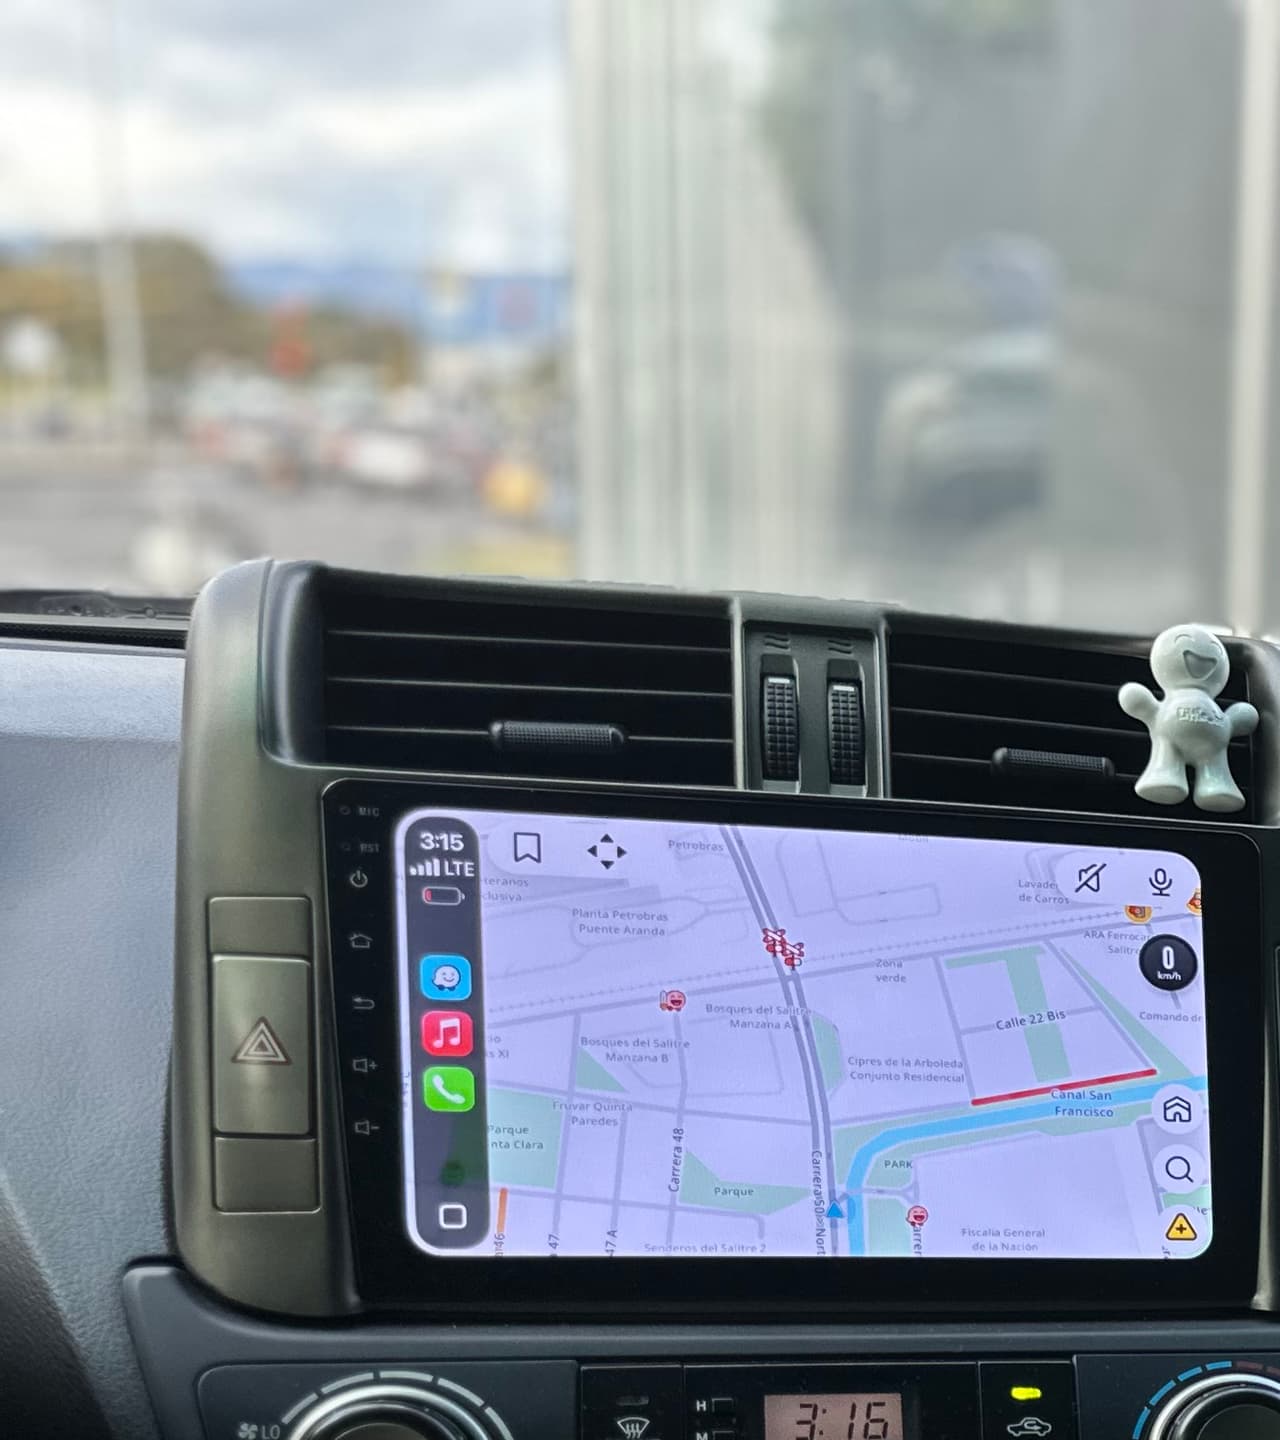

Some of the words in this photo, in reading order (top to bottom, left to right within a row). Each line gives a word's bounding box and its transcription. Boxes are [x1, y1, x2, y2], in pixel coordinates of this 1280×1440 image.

[420, 832, 464, 851] 3:15
[668, 839, 724, 852] Petrobras
[445, 861, 475, 877] LTE
[1019, 893, 1033, 903] de
[1035, 894, 1070, 905] Carros
[572, 908, 609, 920] Planta
[613, 910, 669, 922] Petrobras
[579, 923, 620, 936] Puente
[623, 925, 665, 937] Aranda
[1083, 931, 1105, 940] ARA
[875, 958, 903, 969] Zona
[1162, 945, 1175, 970] 0
[876, 973, 906, 984] verde
[1157, 971, 1182, 982] km/h
[706, 1003, 753, 1017] Bosques
[756, 1003, 773, 1015] del
[776, 1004, 812, 1017] Salitre
[1139, 1011, 1189, 1022] Comando
[730, 1019, 781, 1030] Manzana
[784, 1020, 793, 1030] A
[996, 1017, 1027, 1031] Calle
[1029, 1014, 1045, 1027] 22
[1047, 1009, 1067, 1022] Bis
[580, 1036, 629, 1050] Bosques
[632, 1037, 650, 1048] del
[653, 1038, 691, 1050] Salitre
[605, 1052, 658, 1063] Manzana
[661, 1053, 669, 1063] B
[848, 1056, 883, 1069] Cipres
[884, 1057, 898, 1067] de
[901, 1057, 911, 1068] la
[914, 1058, 964, 1069] Arboleda
[850, 1071, 900, 1084] Conjunto
[903, 1072, 965, 1084] Residencial
[1051, 1089, 1086, 1101] Canal
[1089, 1090, 1112, 1102] San
[553, 1101, 590, 1112] Fruvar
[593, 1101, 633, 1114] Quinta
[1055, 1106, 1114, 1118] Francisco
[571, 1116, 619, 1127] Paredes
[673, 1128, 685, 1143] 48
[513, 1140, 544, 1150] Clara
[668, 1146, 684, 1193] Carrera
[884, 1160, 913, 1169] PARK
[811, 1150, 823, 1197] Carrera
[714, 1187, 754, 1199] Parque
[1004, 1228, 1045, 1239] General
[548, 1234, 559, 1249] 47
[912, 1226, 924, 1256] arrer
[972, 1242, 986, 1252] de
[988, 1242, 999, 1252] la
[645, 1243, 698, 1254] Senderos
[701, 1243, 717, 1253] del
[721, 1243, 759, 1254] Salitre
[759, 1243, 767, 1253] 2
[696, 1400, 707, 1413] H
[261, 1425, 281, 1440] LO
